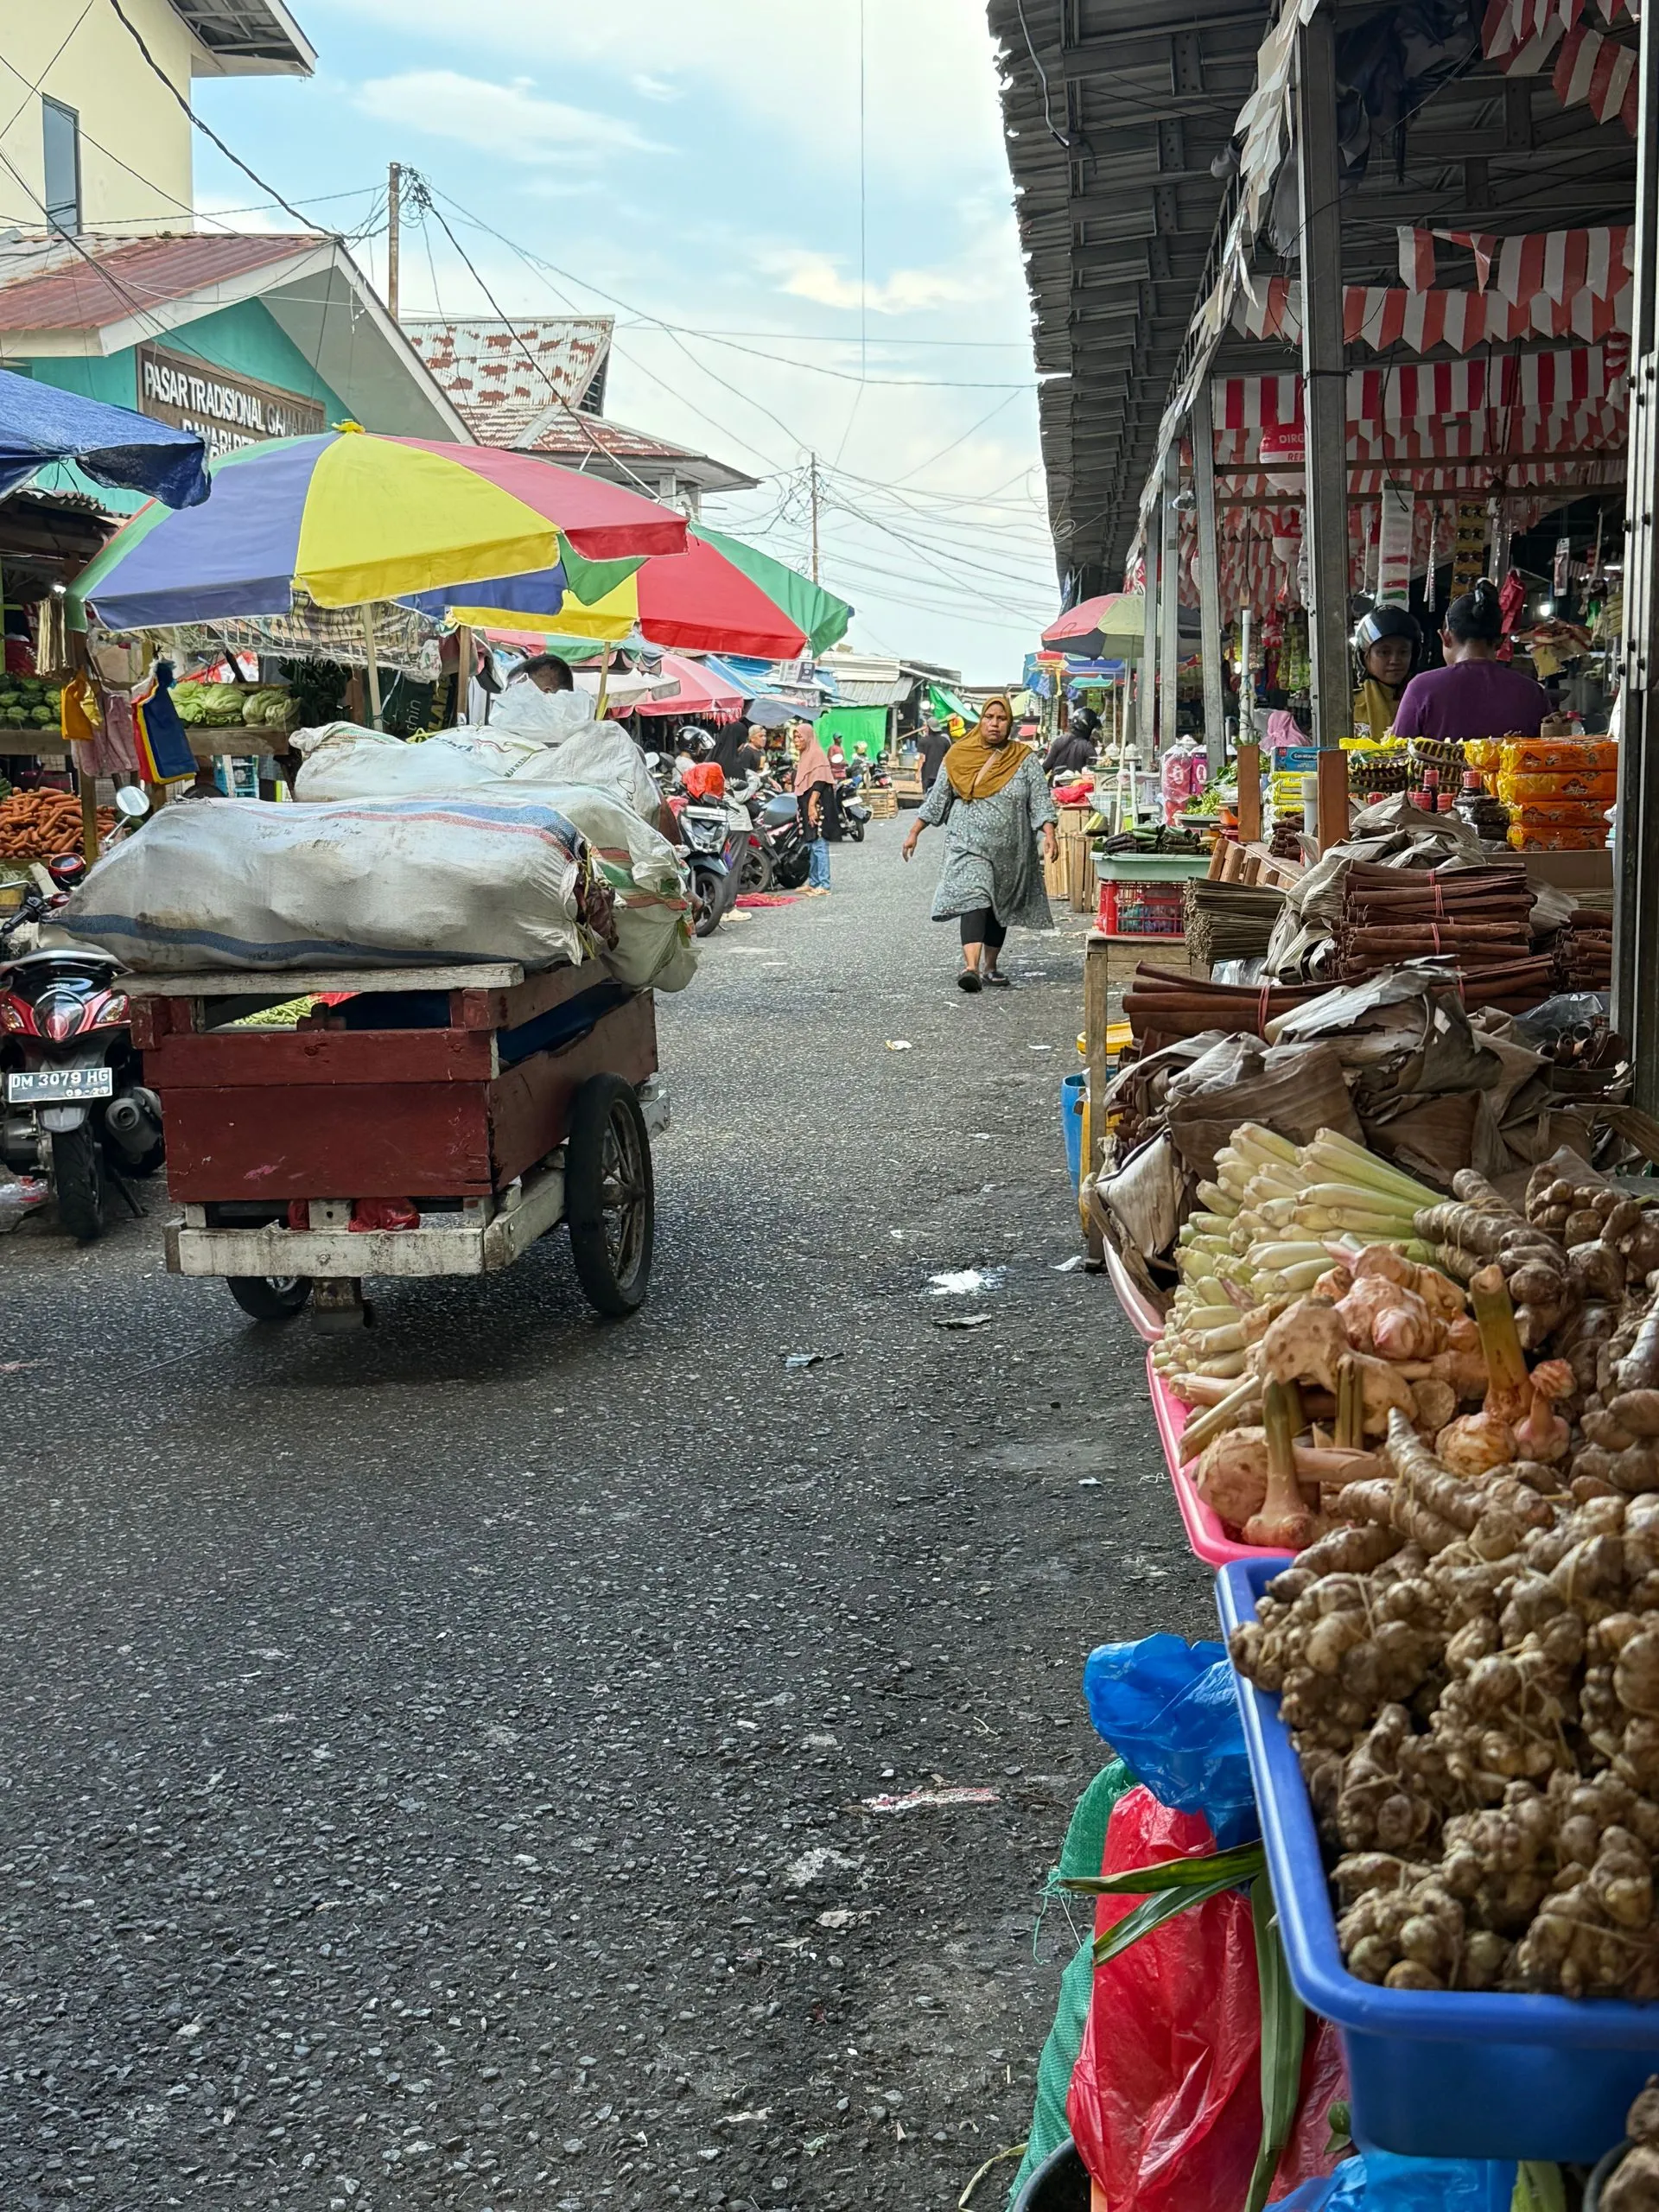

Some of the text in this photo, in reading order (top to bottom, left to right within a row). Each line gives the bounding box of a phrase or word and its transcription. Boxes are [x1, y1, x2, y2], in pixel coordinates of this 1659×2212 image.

[143, 360, 189, 409] PASAR
[188, 376, 266, 431] TRADISIONAL
[12, 1070, 109, 1088] DM 3079 HG
